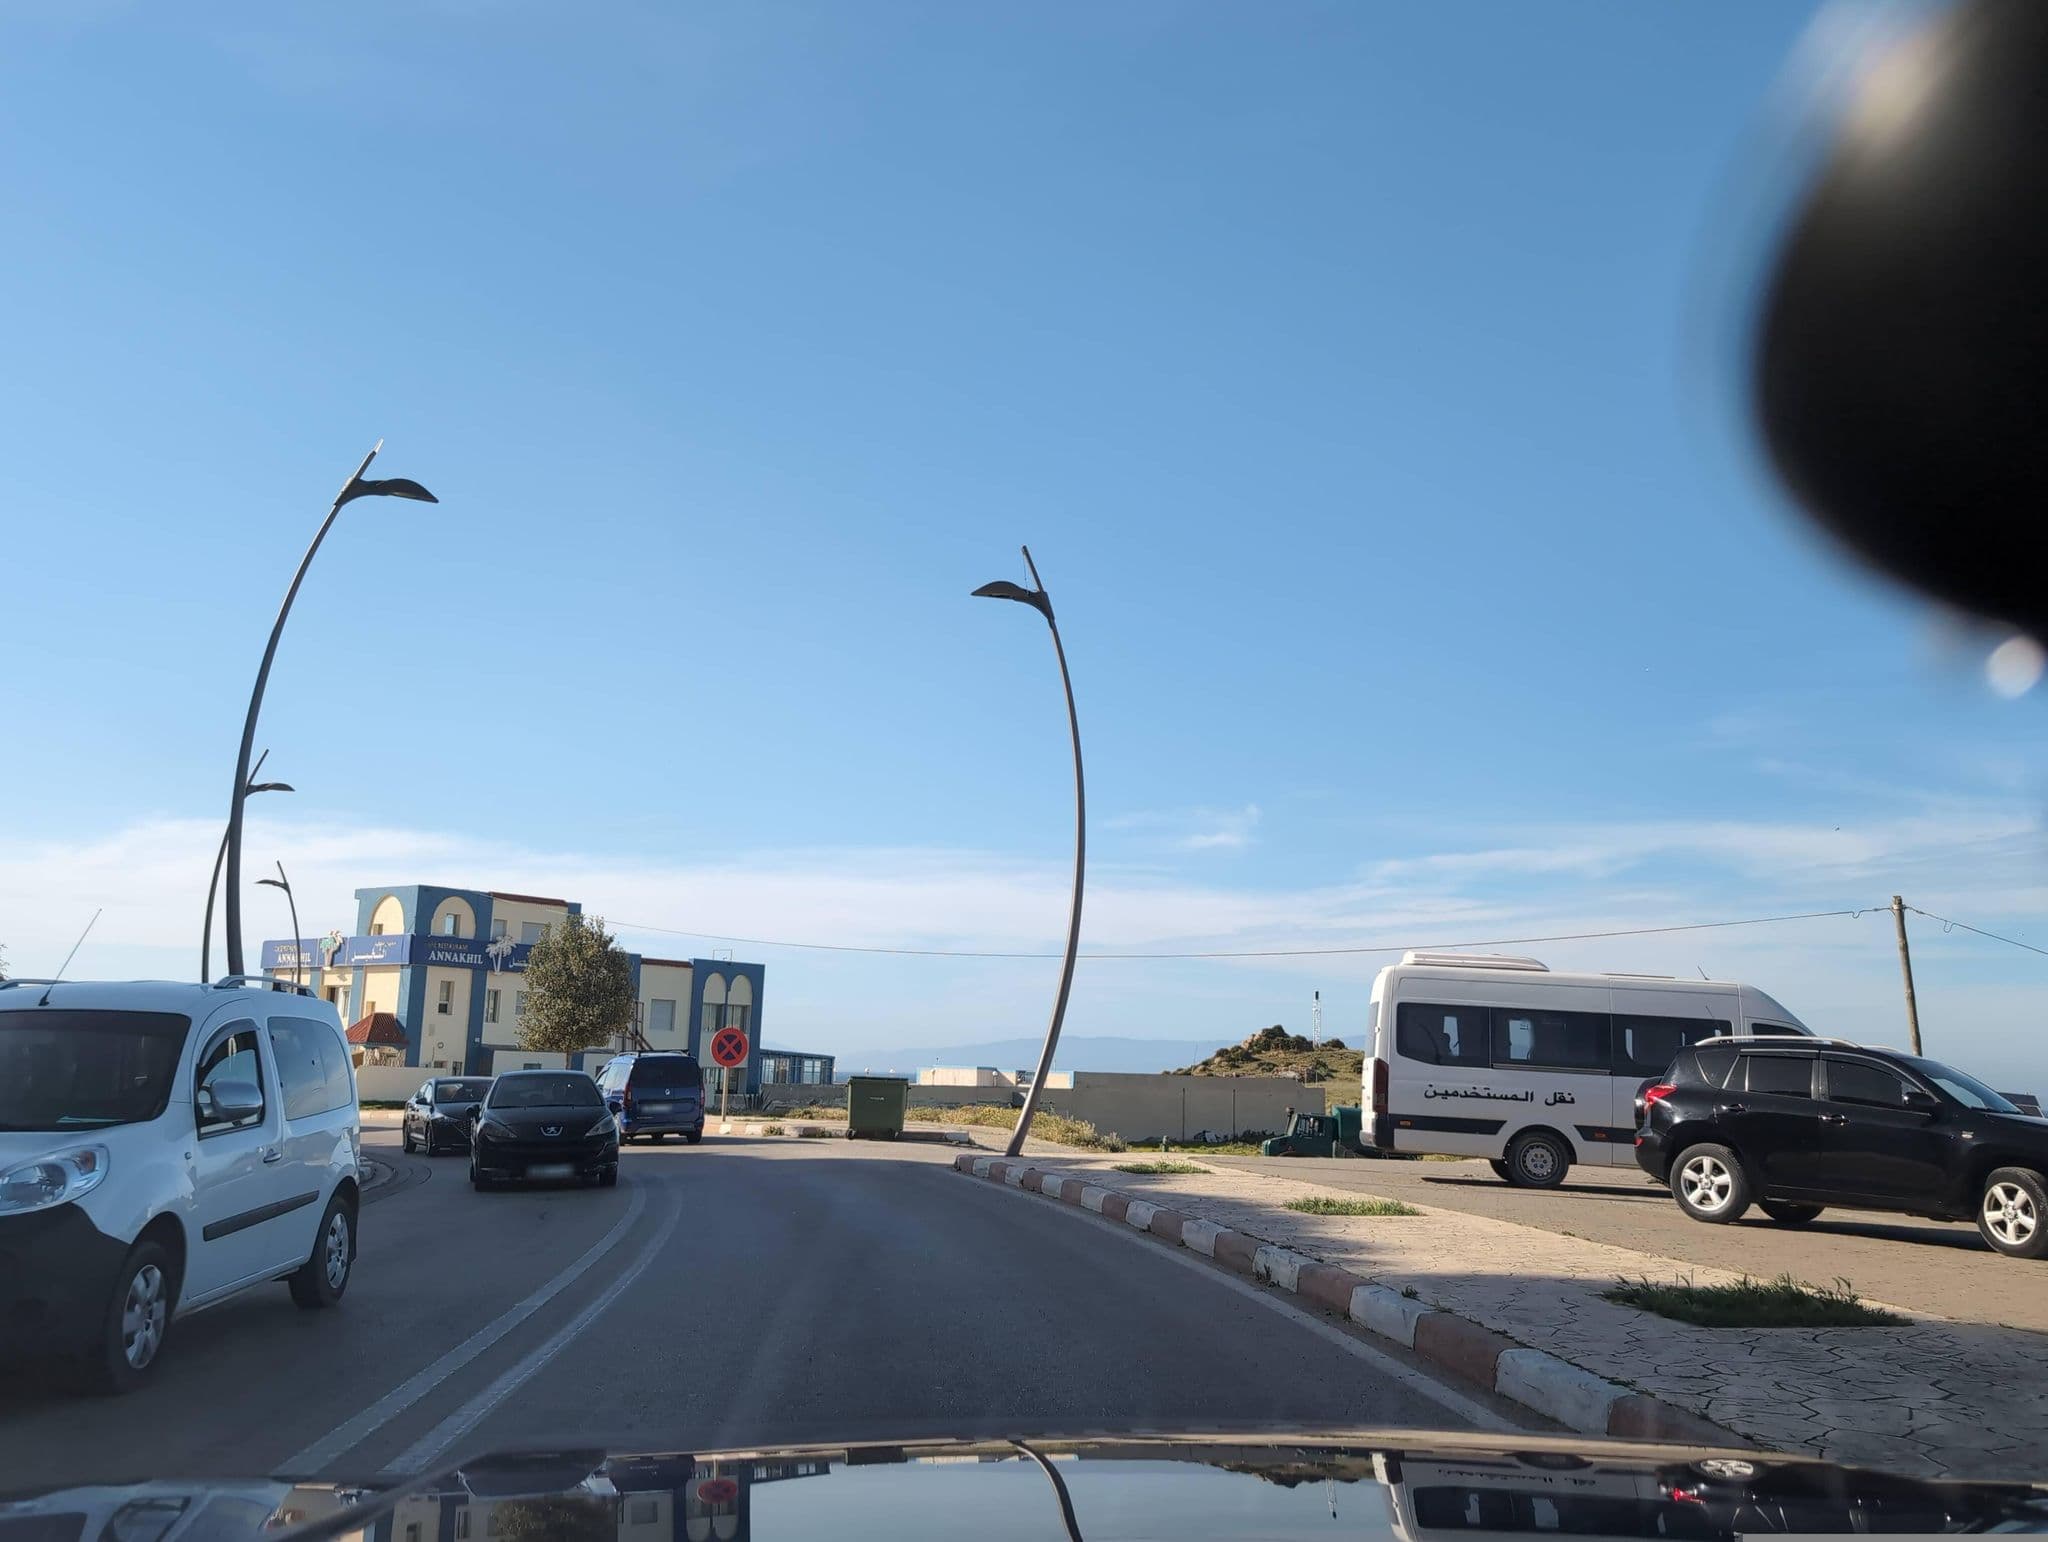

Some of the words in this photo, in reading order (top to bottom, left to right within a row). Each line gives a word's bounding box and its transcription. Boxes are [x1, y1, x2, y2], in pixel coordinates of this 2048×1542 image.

[428, 950, 483, 964] ANNAKHIL
[1424, 1083, 1534, 1103] المستخدمين
[1544, 1091, 1576, 1106] نقل
